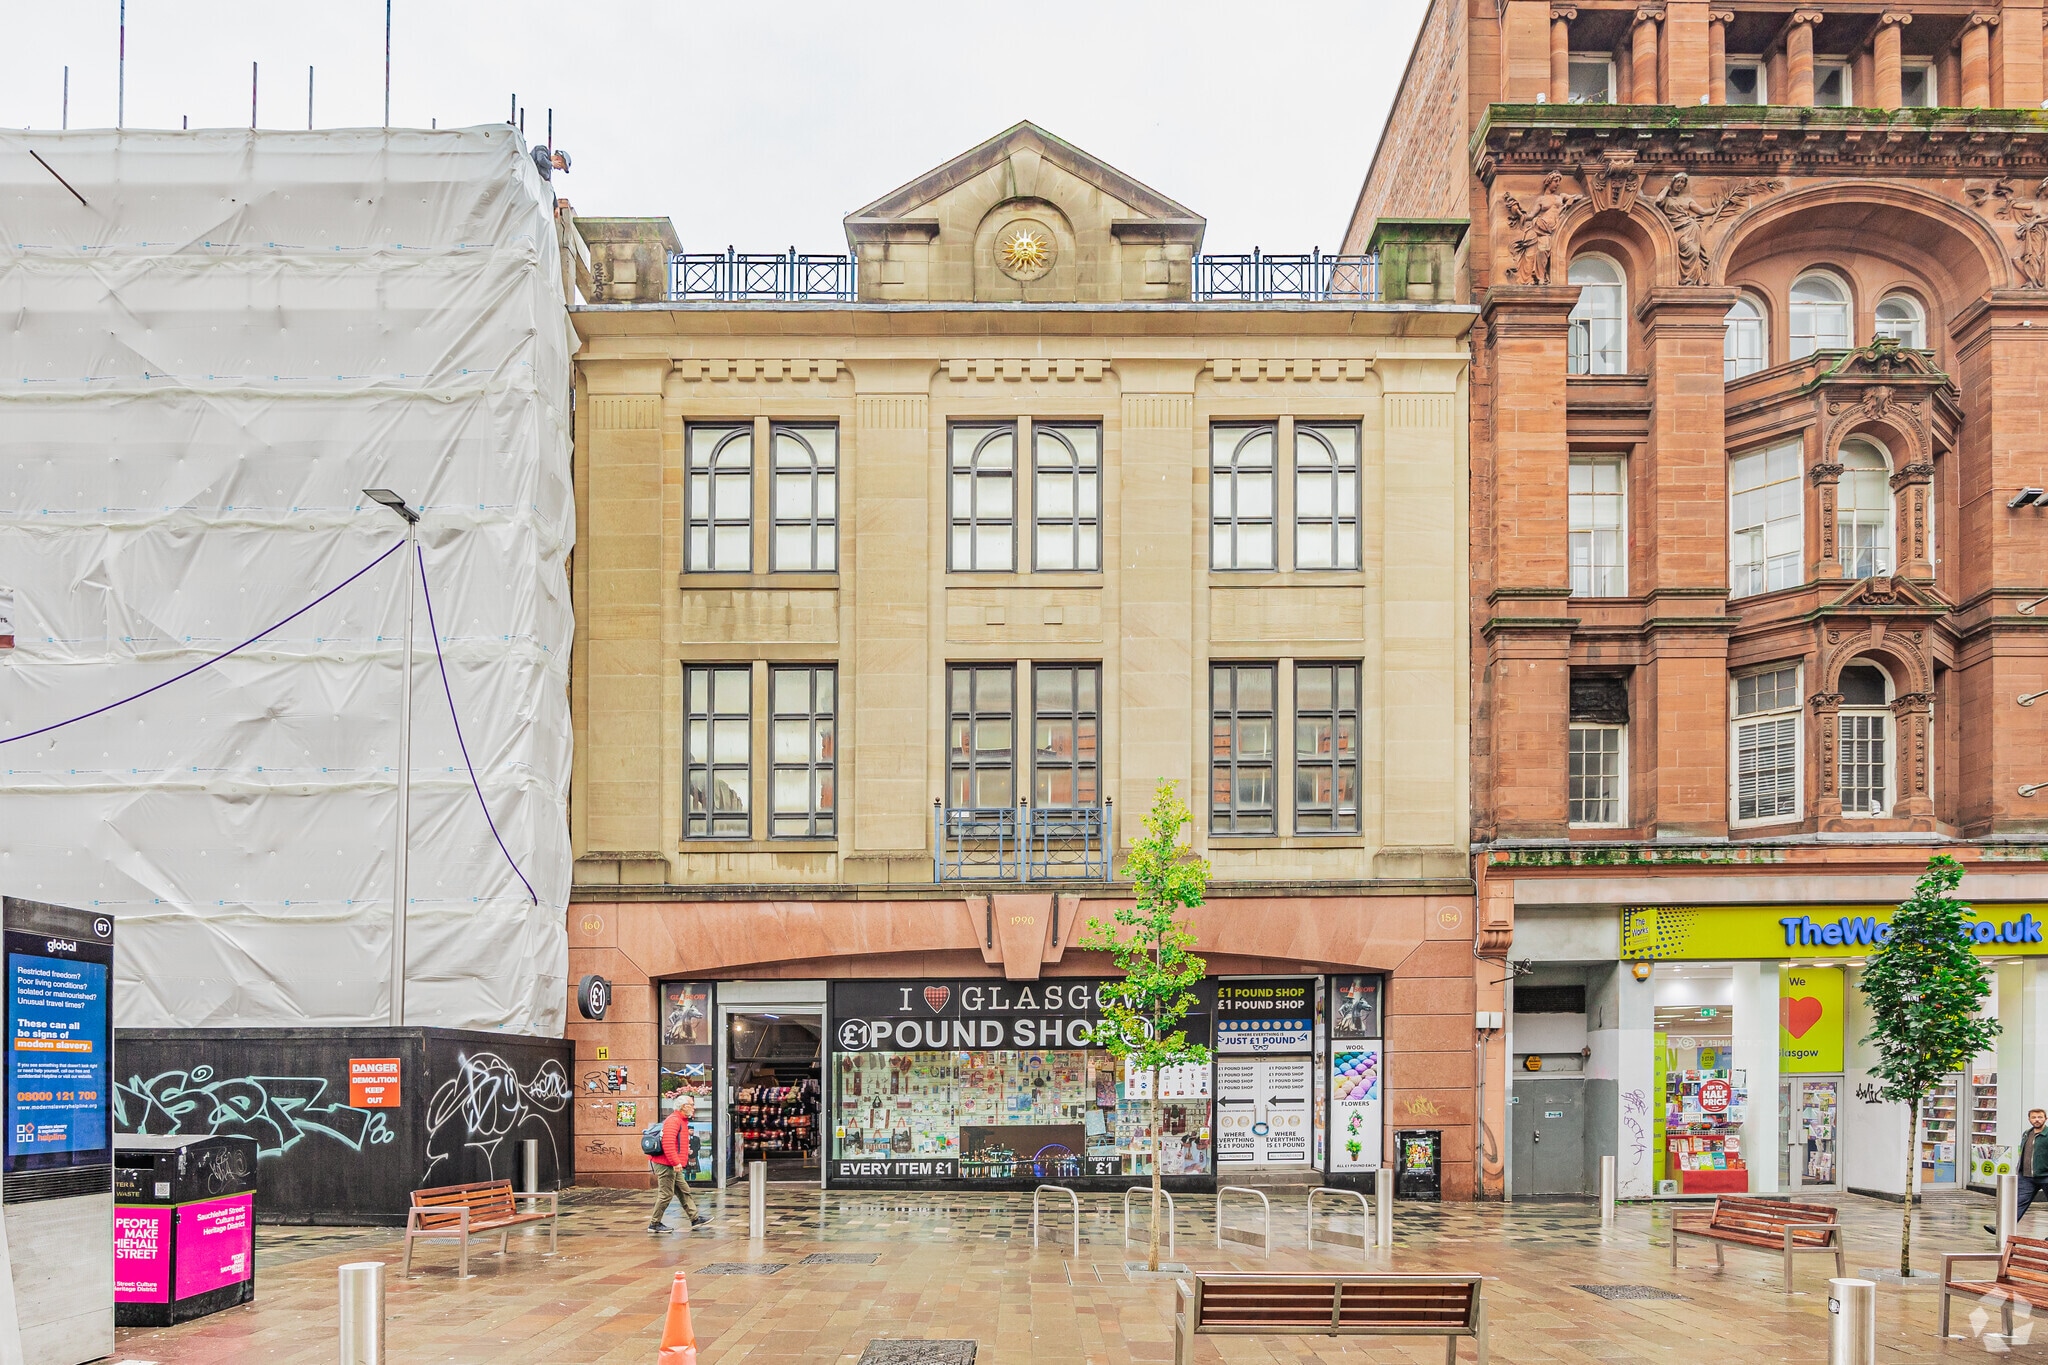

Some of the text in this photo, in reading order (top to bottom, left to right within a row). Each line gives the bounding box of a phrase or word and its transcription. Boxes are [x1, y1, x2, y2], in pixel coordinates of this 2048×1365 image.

[1011, 916, 1035, 926] 1990
[1441, 913, 1457, 922] 154
[1635, 918, 1646, 926] The
[97, 923, 108, 932] BT
[584, 920, 600, 930] 160
[1779, 913, 2043, 946] TheWoco.uk
[1632, 926, 1649, 937] Works
[46, 939, 77, 953] global
[18, 966, 81, 980] Restricted freedom?
[35, 978, 52, 988] living
[53, 981, 87, 990] conditions?
[1790, 978, 1806, 986] We
[18, 987, 43, 996] Isolated
[53, 990, 97, 1000] malnourished?
[592, 987, 602, 1006] £1
[1218, 988, 1304, 998] £1 POUND SHOP
[18, 998, 85, 1009] Unusual travel times?
[900, 988, 912, 1010] I
[1218, 1000, 1304, 1010] £1 POUND SHOP
[18, 1018, 47, 1028] These
[69, 1022, 80, 1030] all
[18, 1029, 31, 1037] be
[32, 1030, 58, 1040] signs
[843, 1024, 868, 1045] £1
[871, 1020, 1003, 1048] POUND
[18, 1040, 90, 1051] modern slavery.
[599, 1049, 607, 1058] H
[352, 1063, 398, 1073] DANGER
[17, 1091, 97, 1102] 08000 121 700
[38, 1134, 67, 1142] helpline
[840, 1162, 952, 1175] EVERY ITEM £1
[1096, 1163, 1112, 1174] £1
[197, 1209, 228, 1221] Sauchiehall
[216, 1216, 234, 1225] Culture
[116, 1218, 158, 1229] PEOPLE
[203, 1221, 245, 1236] Heritage District
[125, 1229, 158, 1239] MAKE
[114, 1239, 158, 1249] HIEHALL
[116, 1249, 157, 1259] STREET
